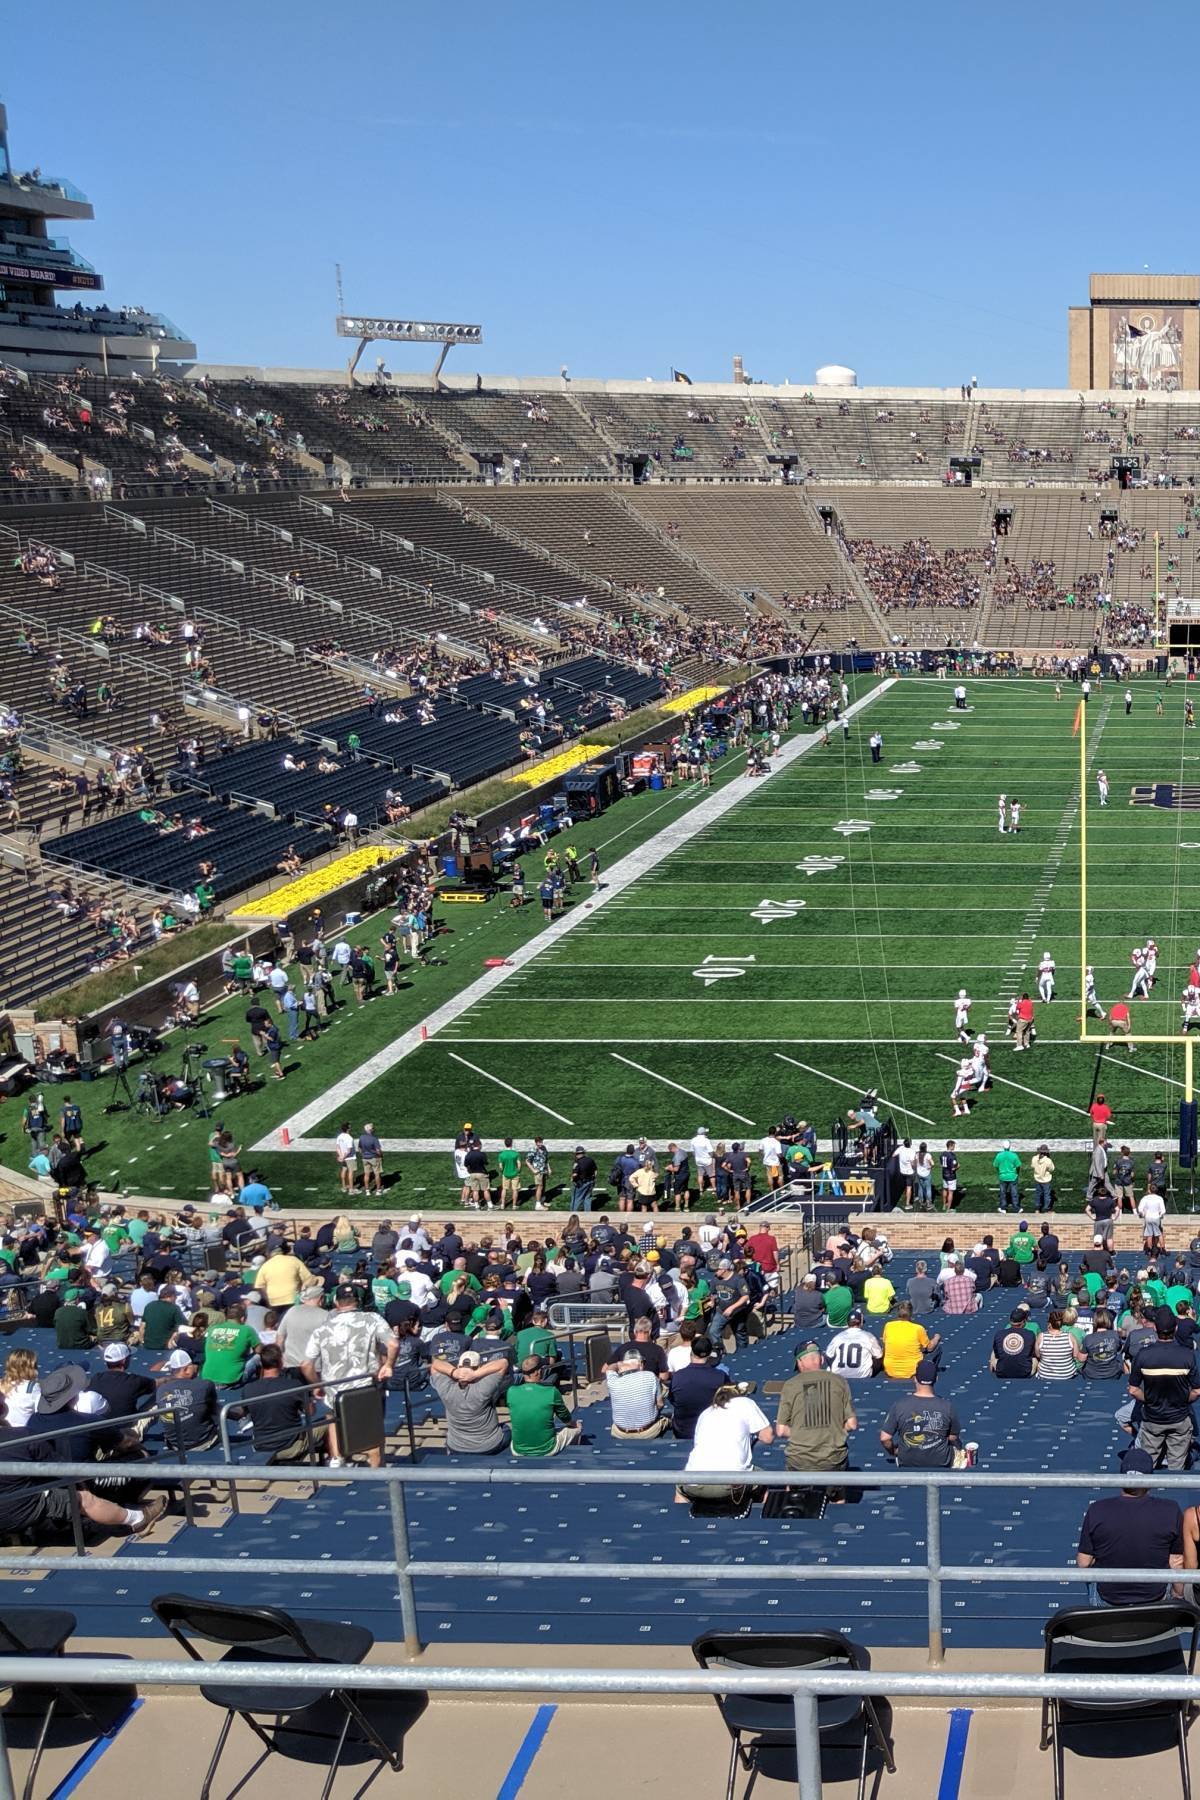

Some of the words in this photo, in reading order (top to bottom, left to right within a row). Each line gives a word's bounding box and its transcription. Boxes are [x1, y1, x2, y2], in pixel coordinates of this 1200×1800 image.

[795, 855, 844, 871] 30
[750, 899, 806, 918] 20
[692, 954, 755, 977] 10
[98, 1308, 114, 1328] 14
[838, 1343, 862, 1369] 10
